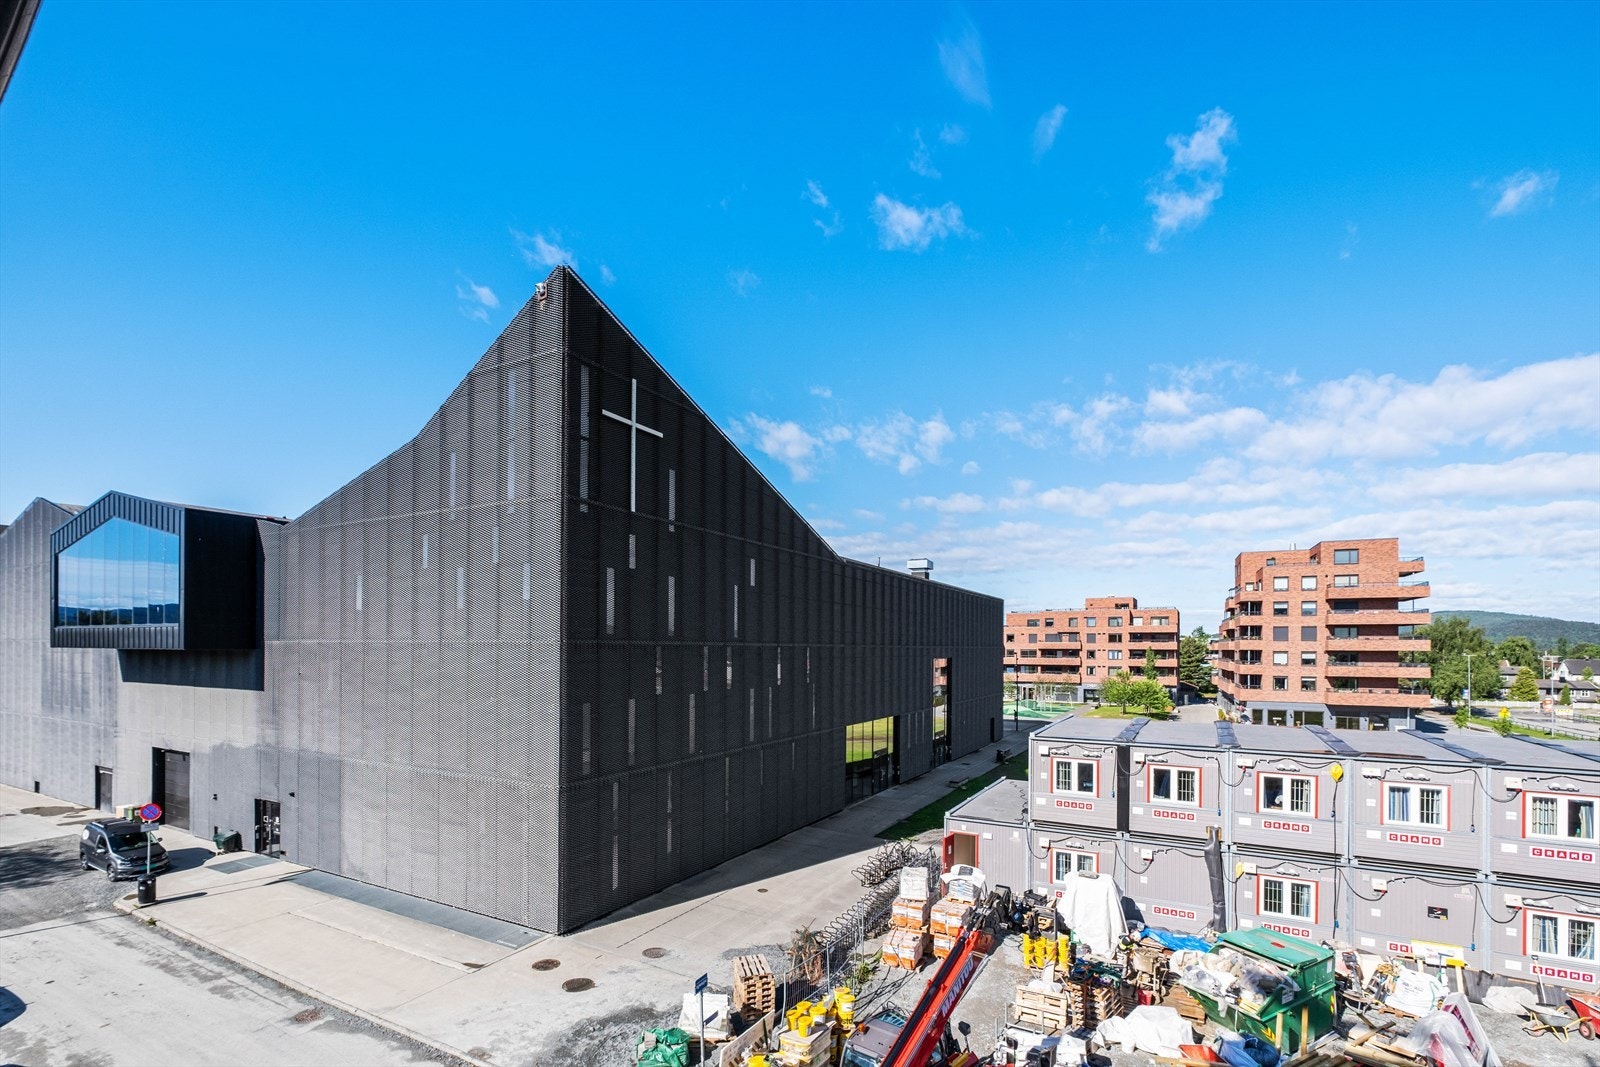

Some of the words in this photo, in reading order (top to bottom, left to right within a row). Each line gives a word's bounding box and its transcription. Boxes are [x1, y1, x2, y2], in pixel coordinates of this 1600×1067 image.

[1056, 799, 1093, 810] CRAMO
[1153, 809, 1195, 821] CRAMO
[1263, 820, 1310, 833] CRAMO
[1389, 833, 1442, 846] CRAMO
[1532, 847, 1593, 862] CRAMO
[1153, 905, 1195, 919] CRAMO
[940, 956, 975, 1018] MANITOU
